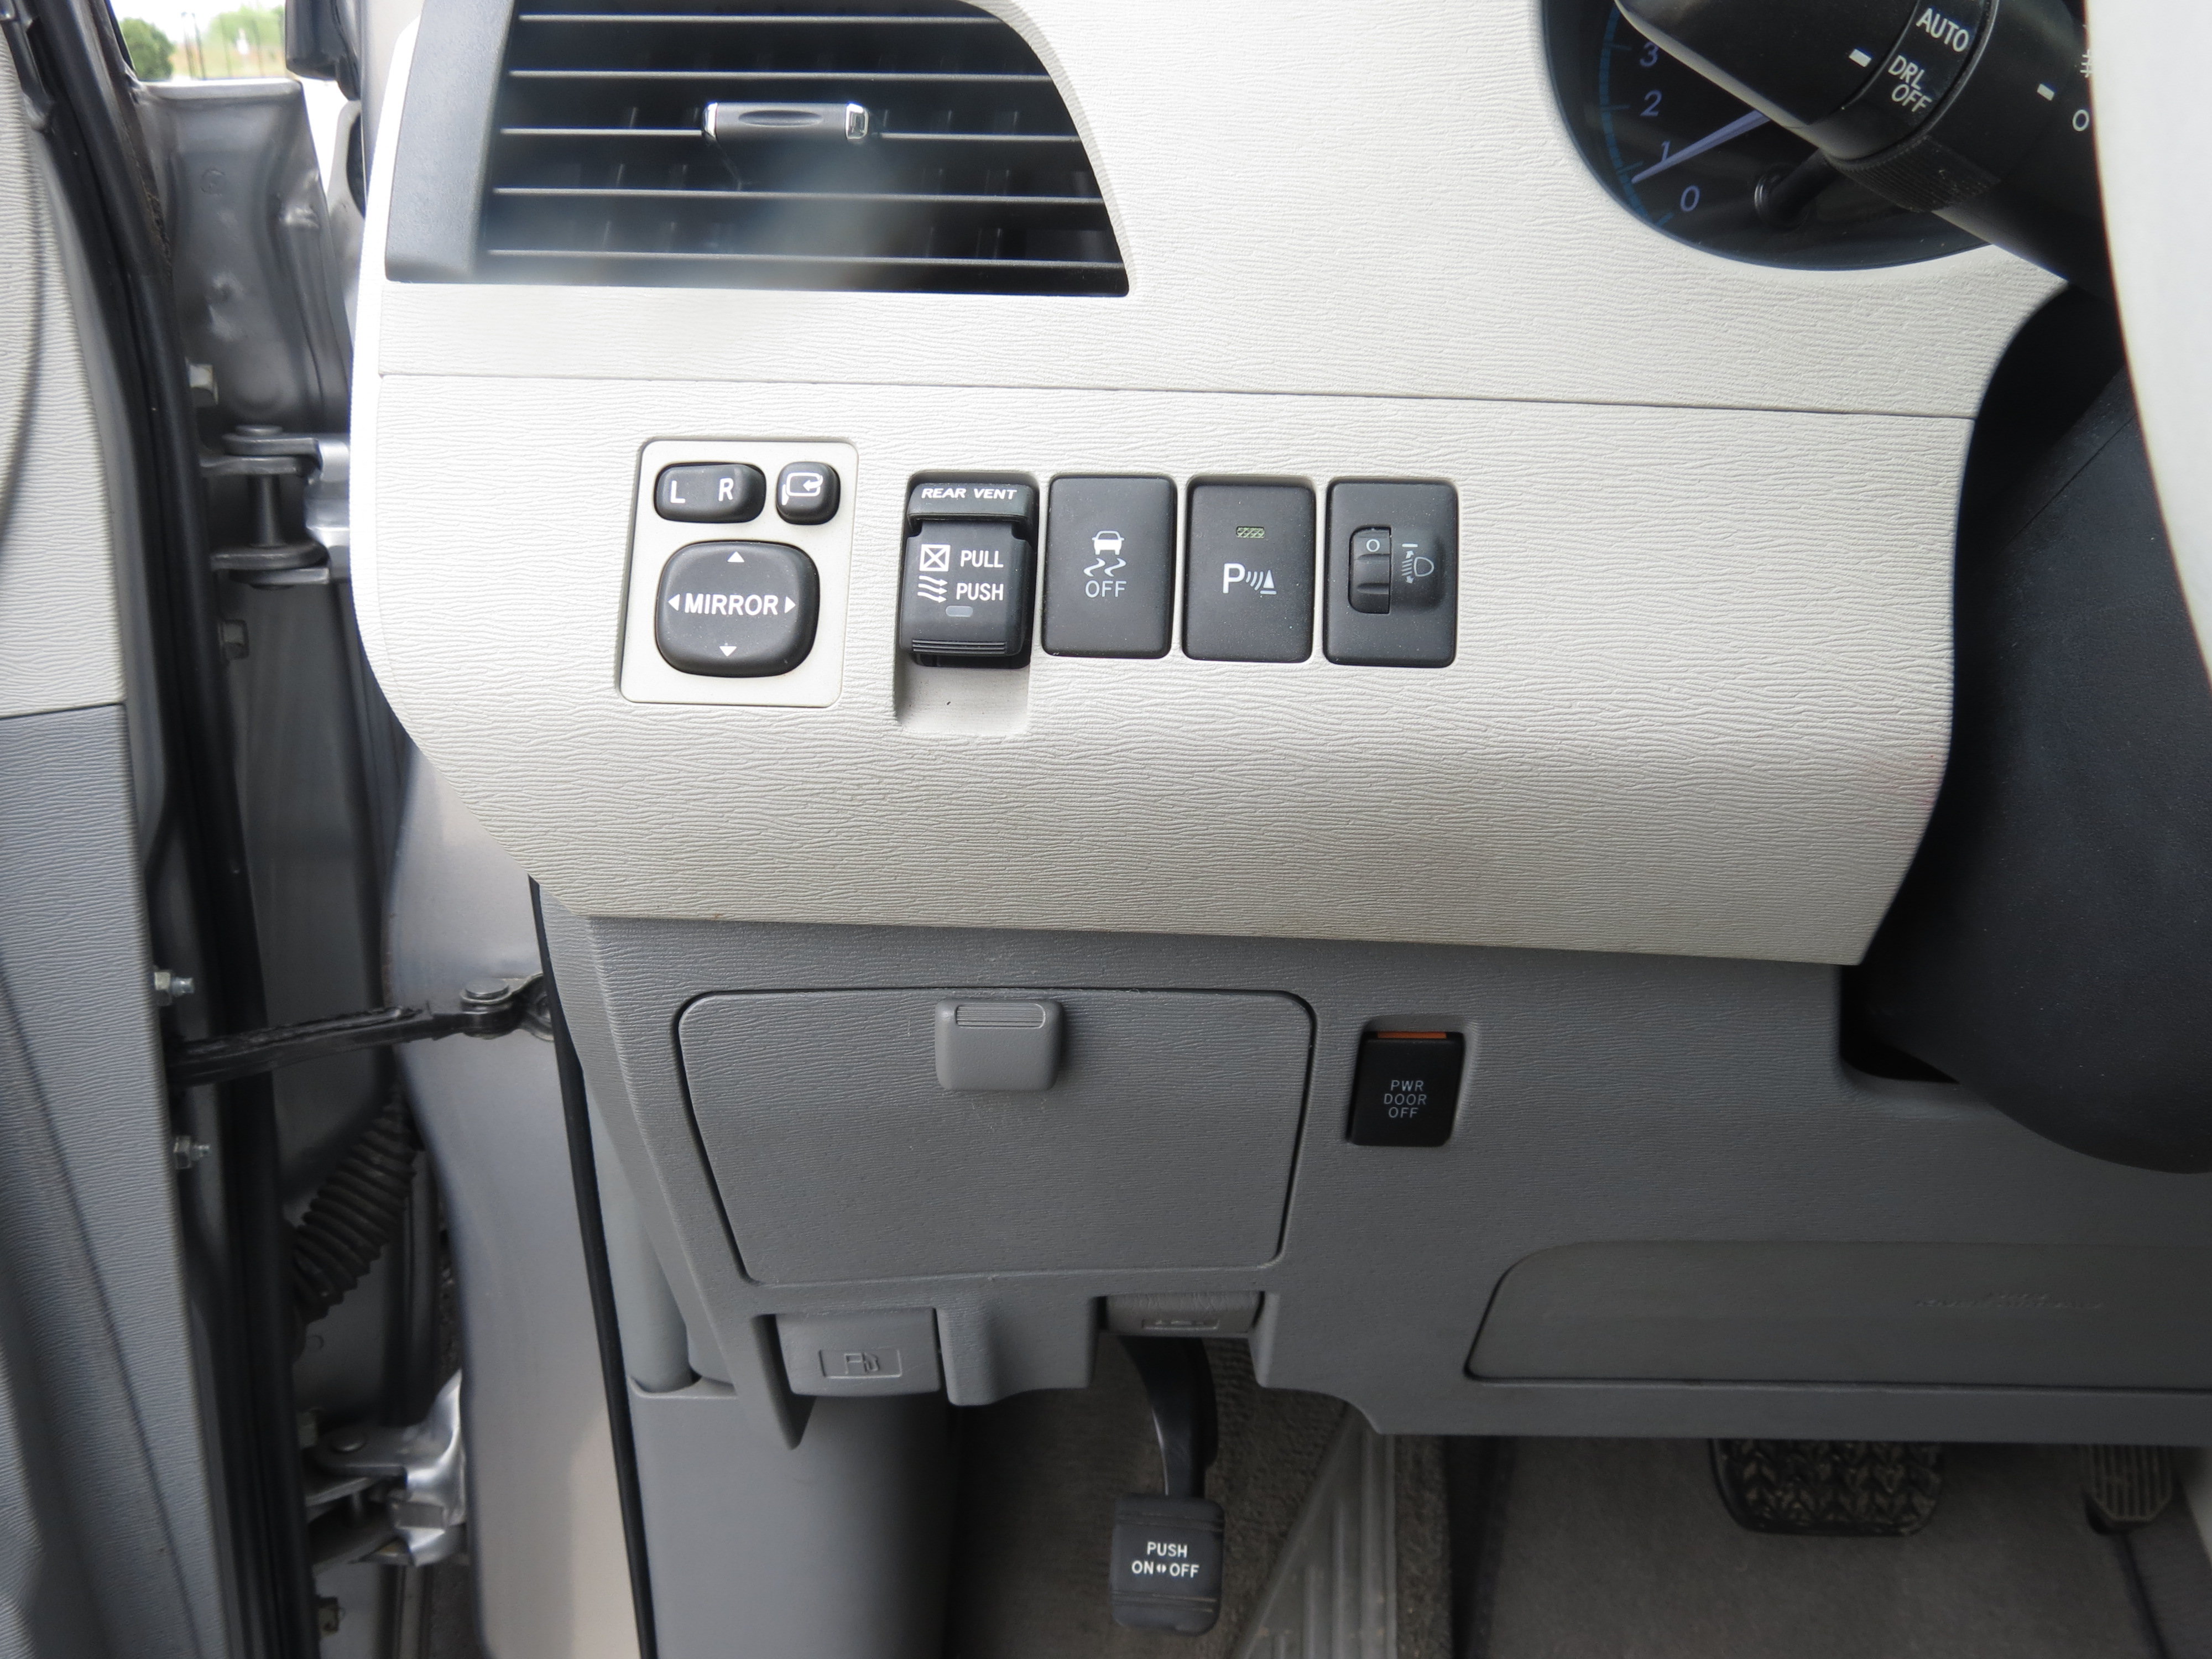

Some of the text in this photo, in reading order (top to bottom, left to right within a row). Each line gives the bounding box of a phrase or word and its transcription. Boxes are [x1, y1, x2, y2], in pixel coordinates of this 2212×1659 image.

[1916, 8, 1970, 53] AUTO
[1639, 41, 1659, 67] 3
[1887, 55, 1924, 91] DRL
[1640, 90, 1662, 117] 2
[1891, 84, 1933, 112] OFF
[1661, 140, 1672, 164] 1
[1679, 185, 1700, 213] 0
[670, 480, 686, 504] L
[718, 477, 734, 502] R
[921, 488, 1018, 500] REAR VENT
[960, 550, 1004, 568] PULL
[1085, 580, 1127, 598] OFF
[1222, 563, 1244, 594] P
[956, 582, 1004, 601] PUSH
[684, 593, 778, 616] MIRROR
[1390, 1079, 1424, 1092] PWR
[1383, 1093, 1427, 1105] DOOR
[1388, 1107, 1418, 1118] OFF
[1146, 1541, 1188, 1558] PUSH
[1131, 1560, 1199, 1578] ON OFF
